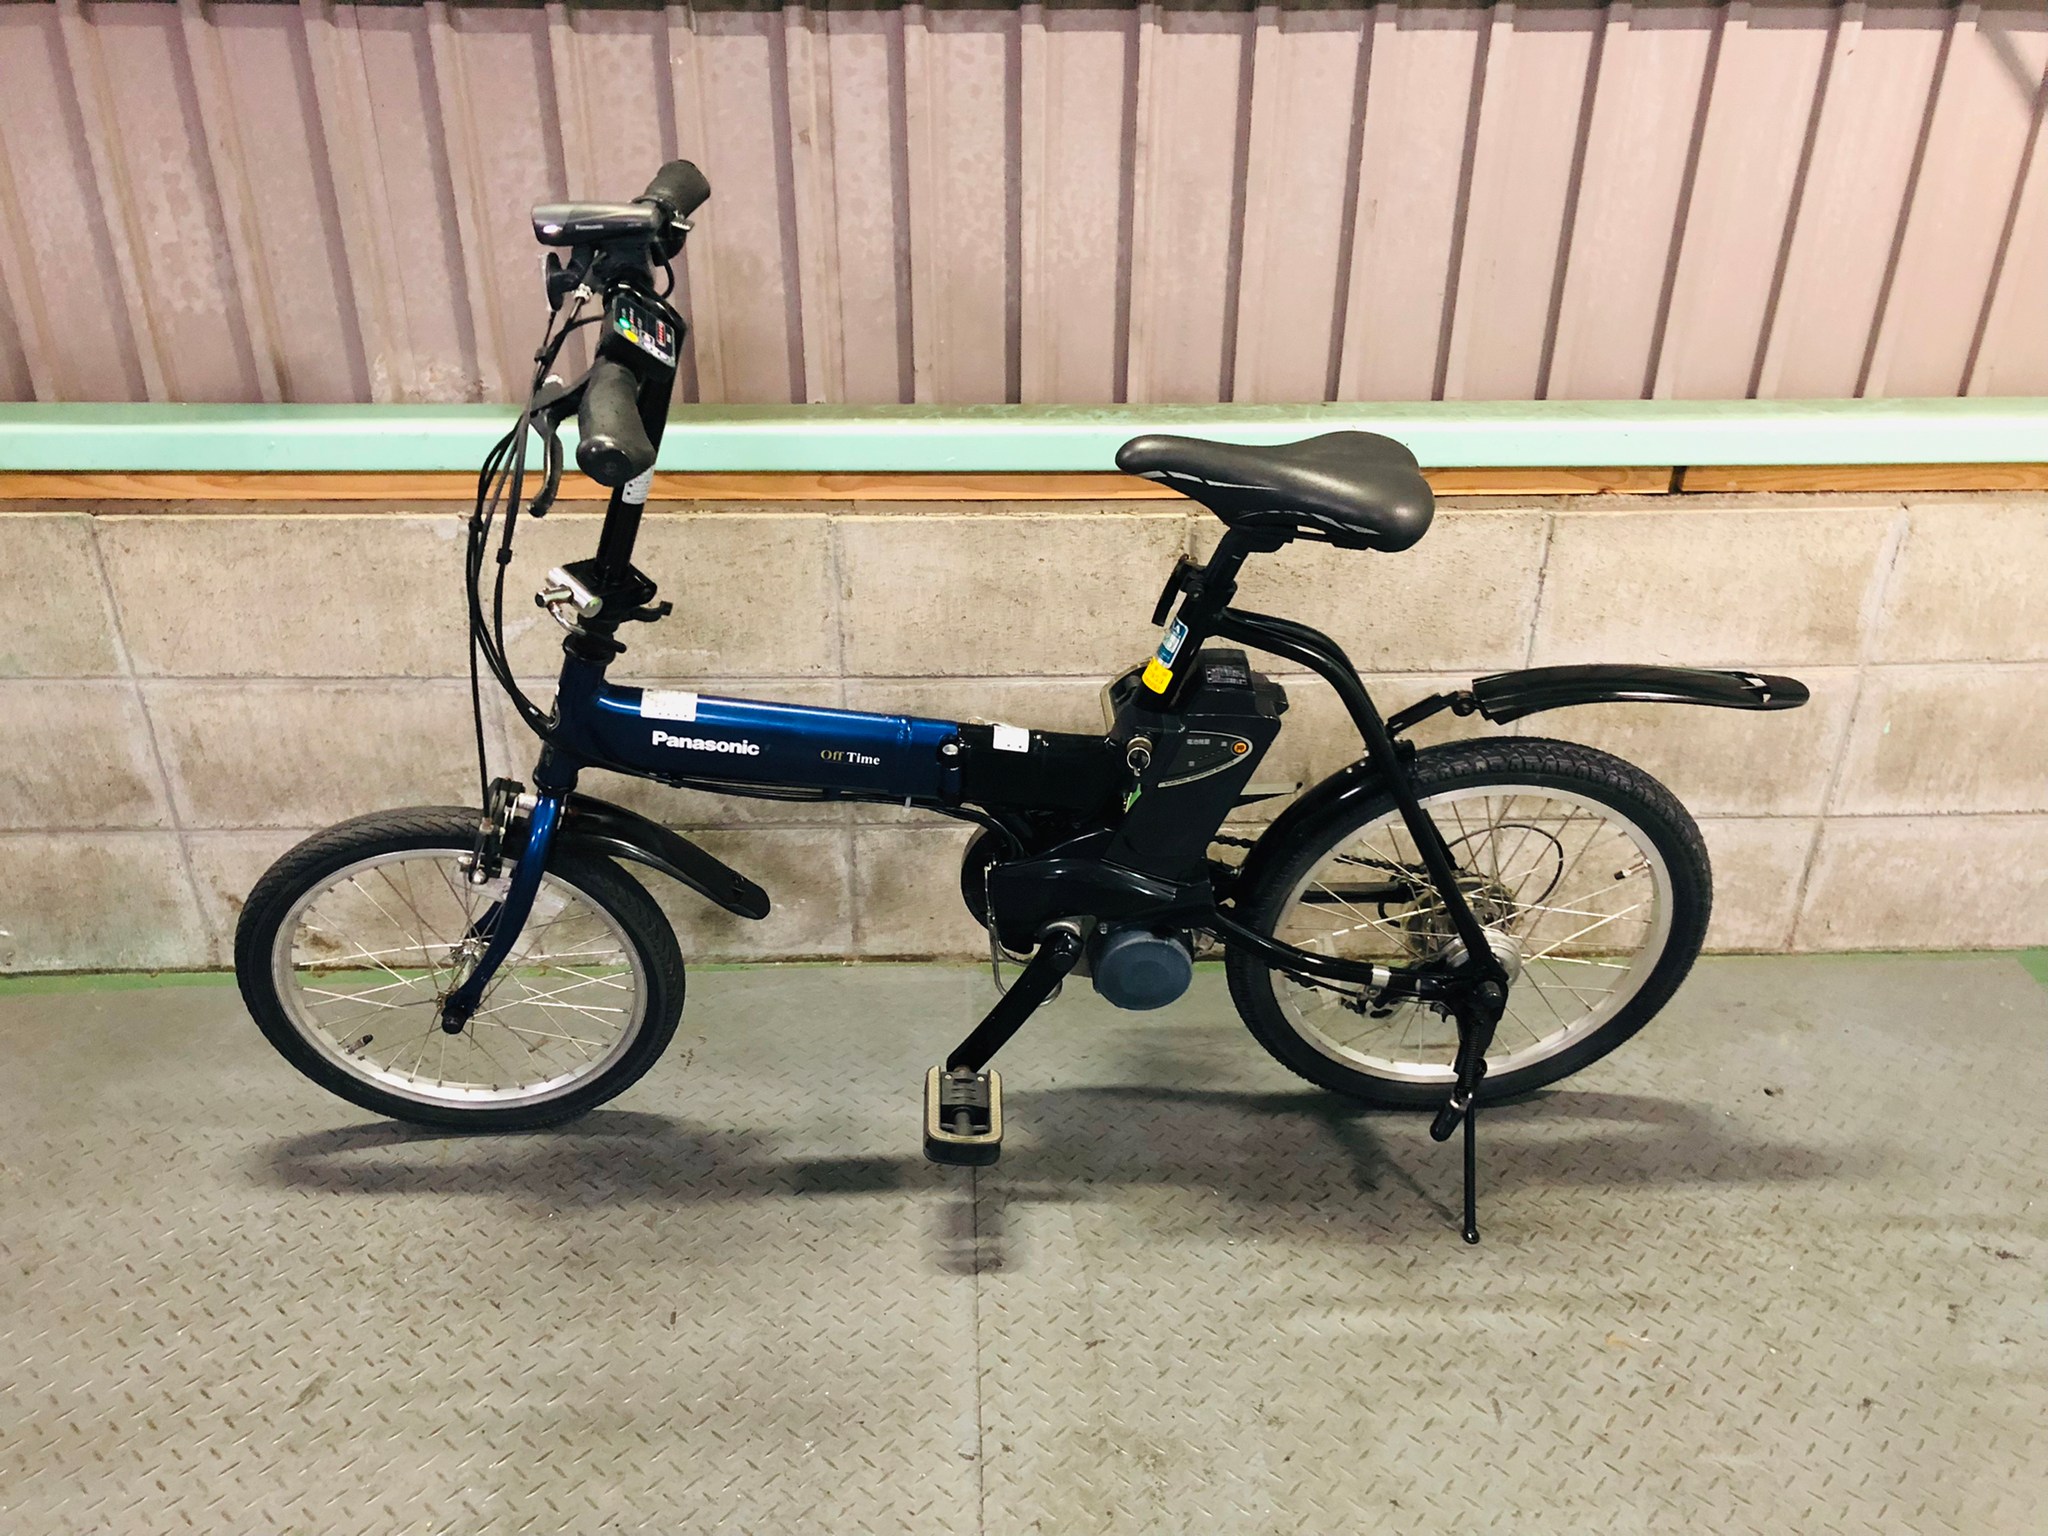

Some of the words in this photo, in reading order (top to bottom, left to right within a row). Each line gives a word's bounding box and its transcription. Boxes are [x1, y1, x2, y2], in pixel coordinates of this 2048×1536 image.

[652, 730, 760, 756] Panasonic
[820, 749, 845, 761] Off
[846, 751, 880, 765] Time
